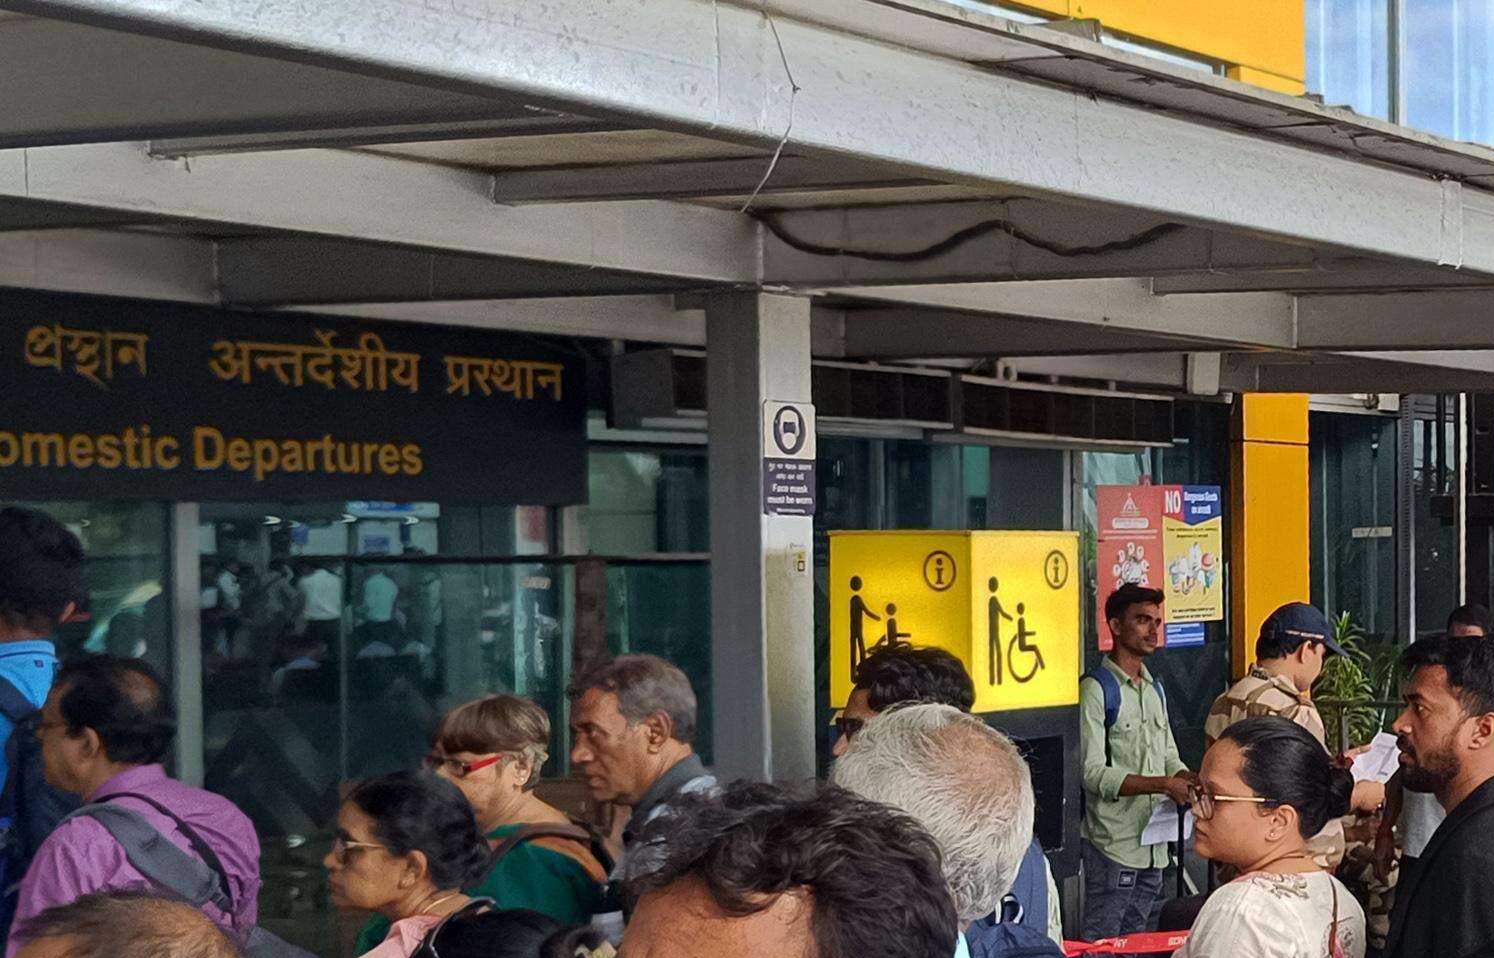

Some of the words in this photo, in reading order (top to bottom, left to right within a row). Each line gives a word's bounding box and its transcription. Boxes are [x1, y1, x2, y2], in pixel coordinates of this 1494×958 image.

[208, 329, 421, 393] अन्तर्देशीय
[444, 355, 564, 400] प्रस्थान
[0, 423, 181, 470] omestic
[193, 425, 423, 480] Departures
[1164, 490, 1182, 515] NO
